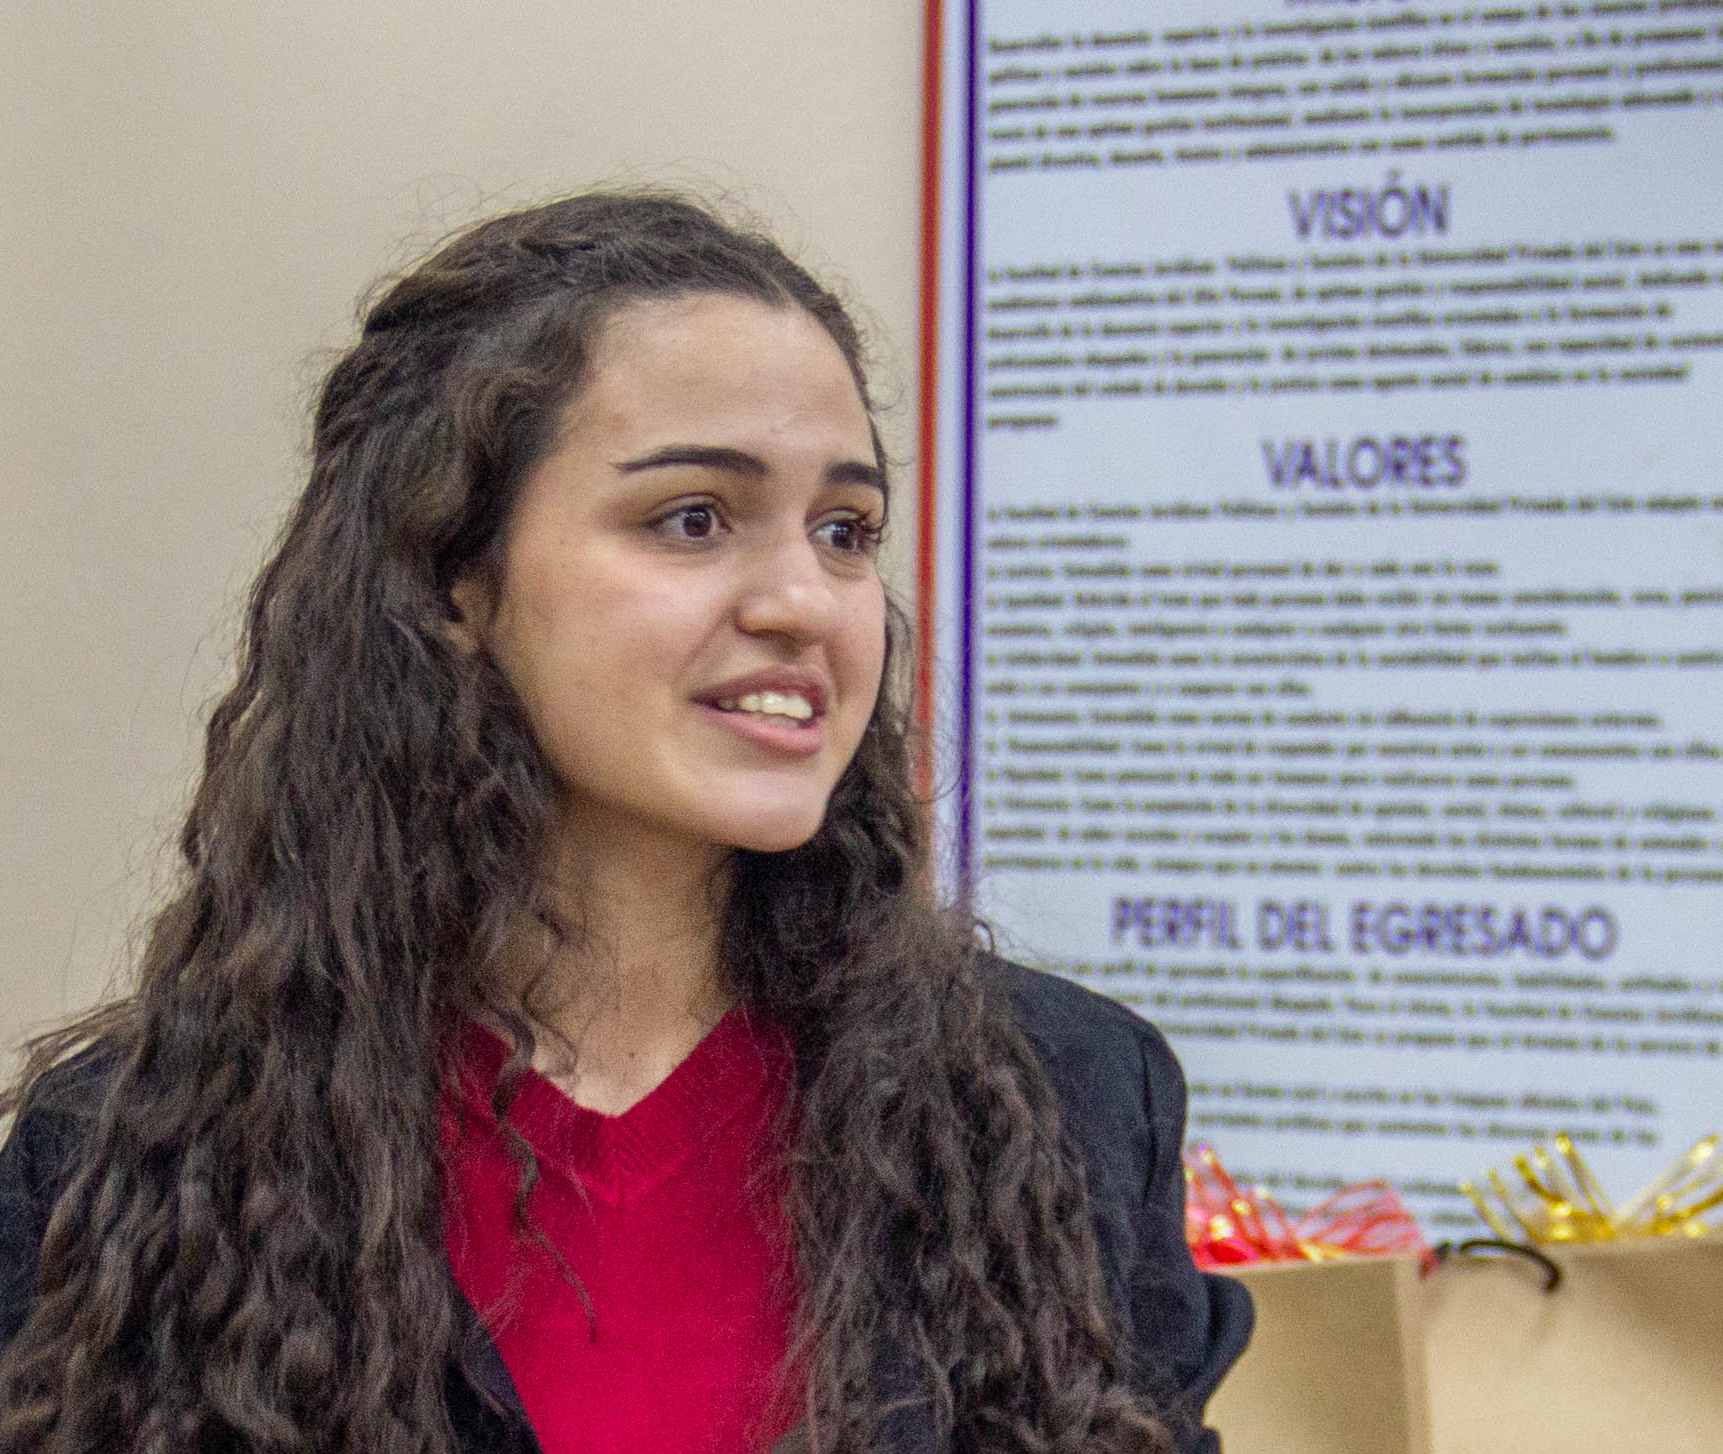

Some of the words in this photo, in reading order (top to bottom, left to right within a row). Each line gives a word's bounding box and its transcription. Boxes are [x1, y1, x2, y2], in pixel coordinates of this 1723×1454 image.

[1287, 168, 1451, 240] VISIÓN
[1260, 433, 1467, 490] VALORES
[1112, 895, 1244, 951] PERFIL
[1255, 898, 1335, 954] DEL
[1347, 899, 1621, 962] EGRESADO
